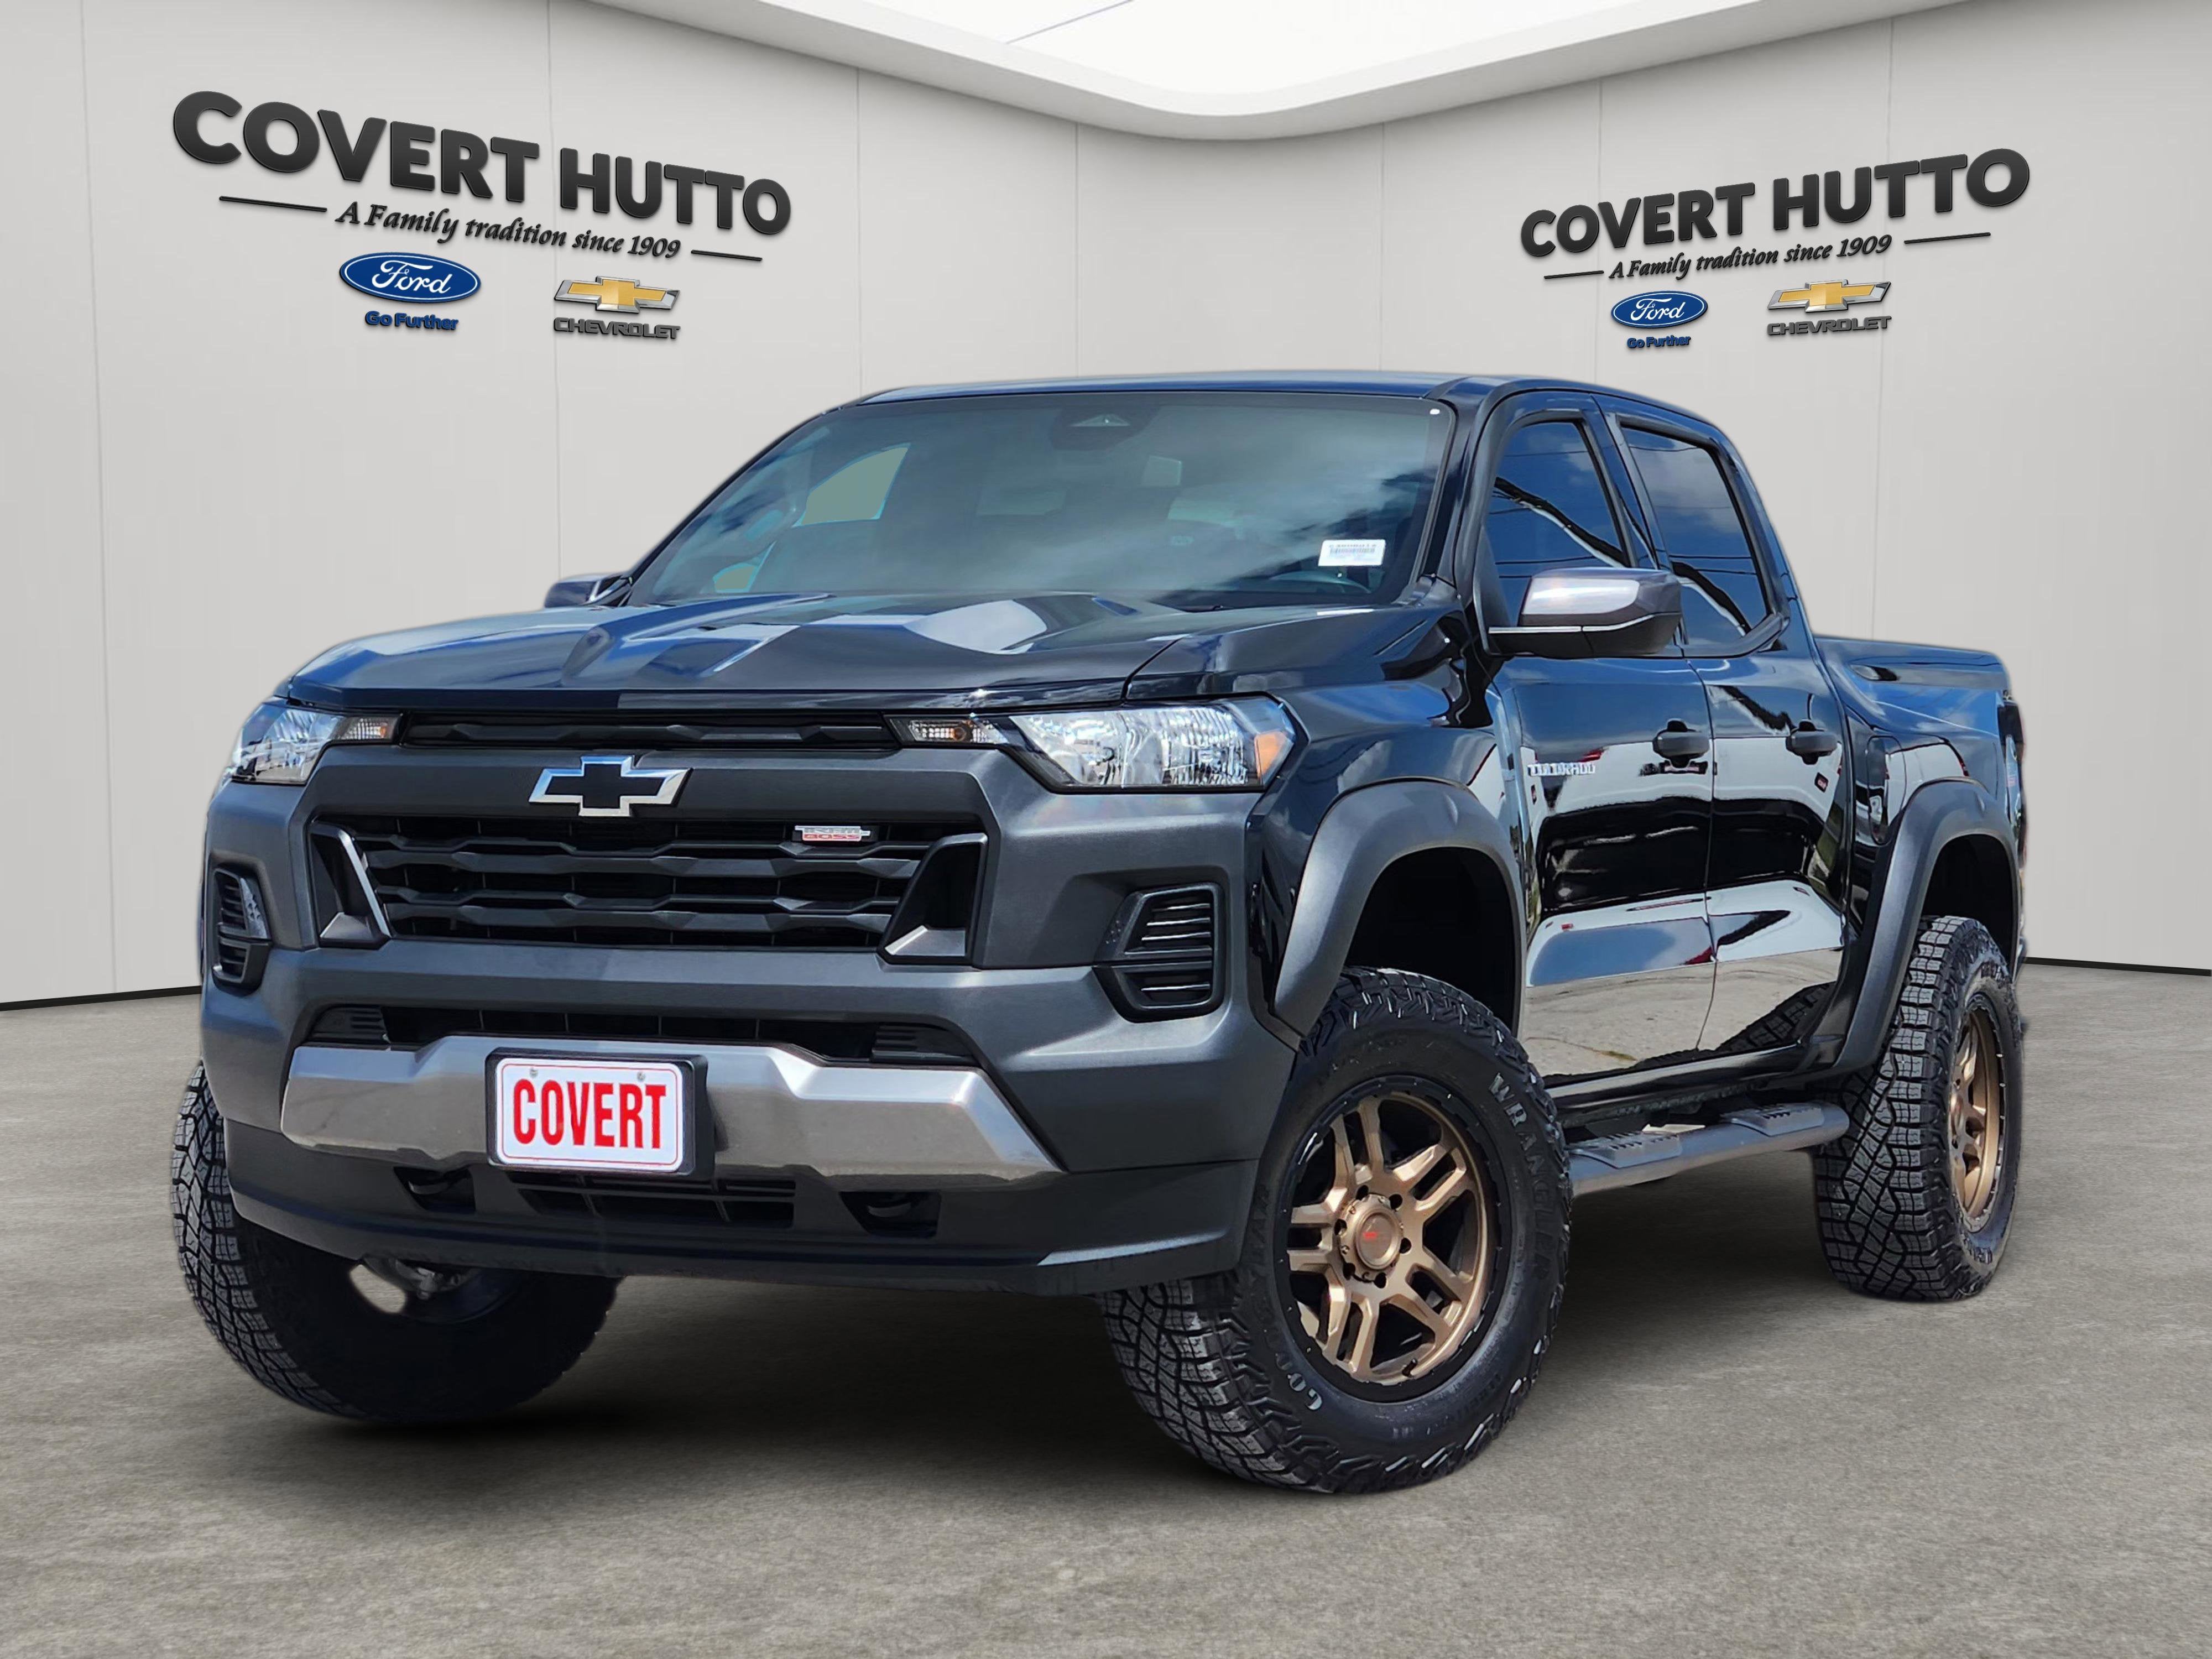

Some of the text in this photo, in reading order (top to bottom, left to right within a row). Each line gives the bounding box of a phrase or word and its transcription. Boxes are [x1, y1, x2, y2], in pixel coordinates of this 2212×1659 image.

[173, 91, 791, 236] COVERT HUTTO
[1521, 149, 2030, 258] COVERT HUTTO
[335, 201, 681, 258] A Family tradition since 1909
[1609, 234, 1892, 280] A Family tradition since 1909
[371, 259, 453, 294] Ford
[365, 310, 459, 331] Go Further
[1630, 298, 1686, 321] Ford
[1767, 315, 1892, 336] CHEVROLET
[554, 317, 681, 340] CHEVROLET
[1627, 335, 1692, 349] Go Further
[513, 1078, 667, 1149] COVERT
